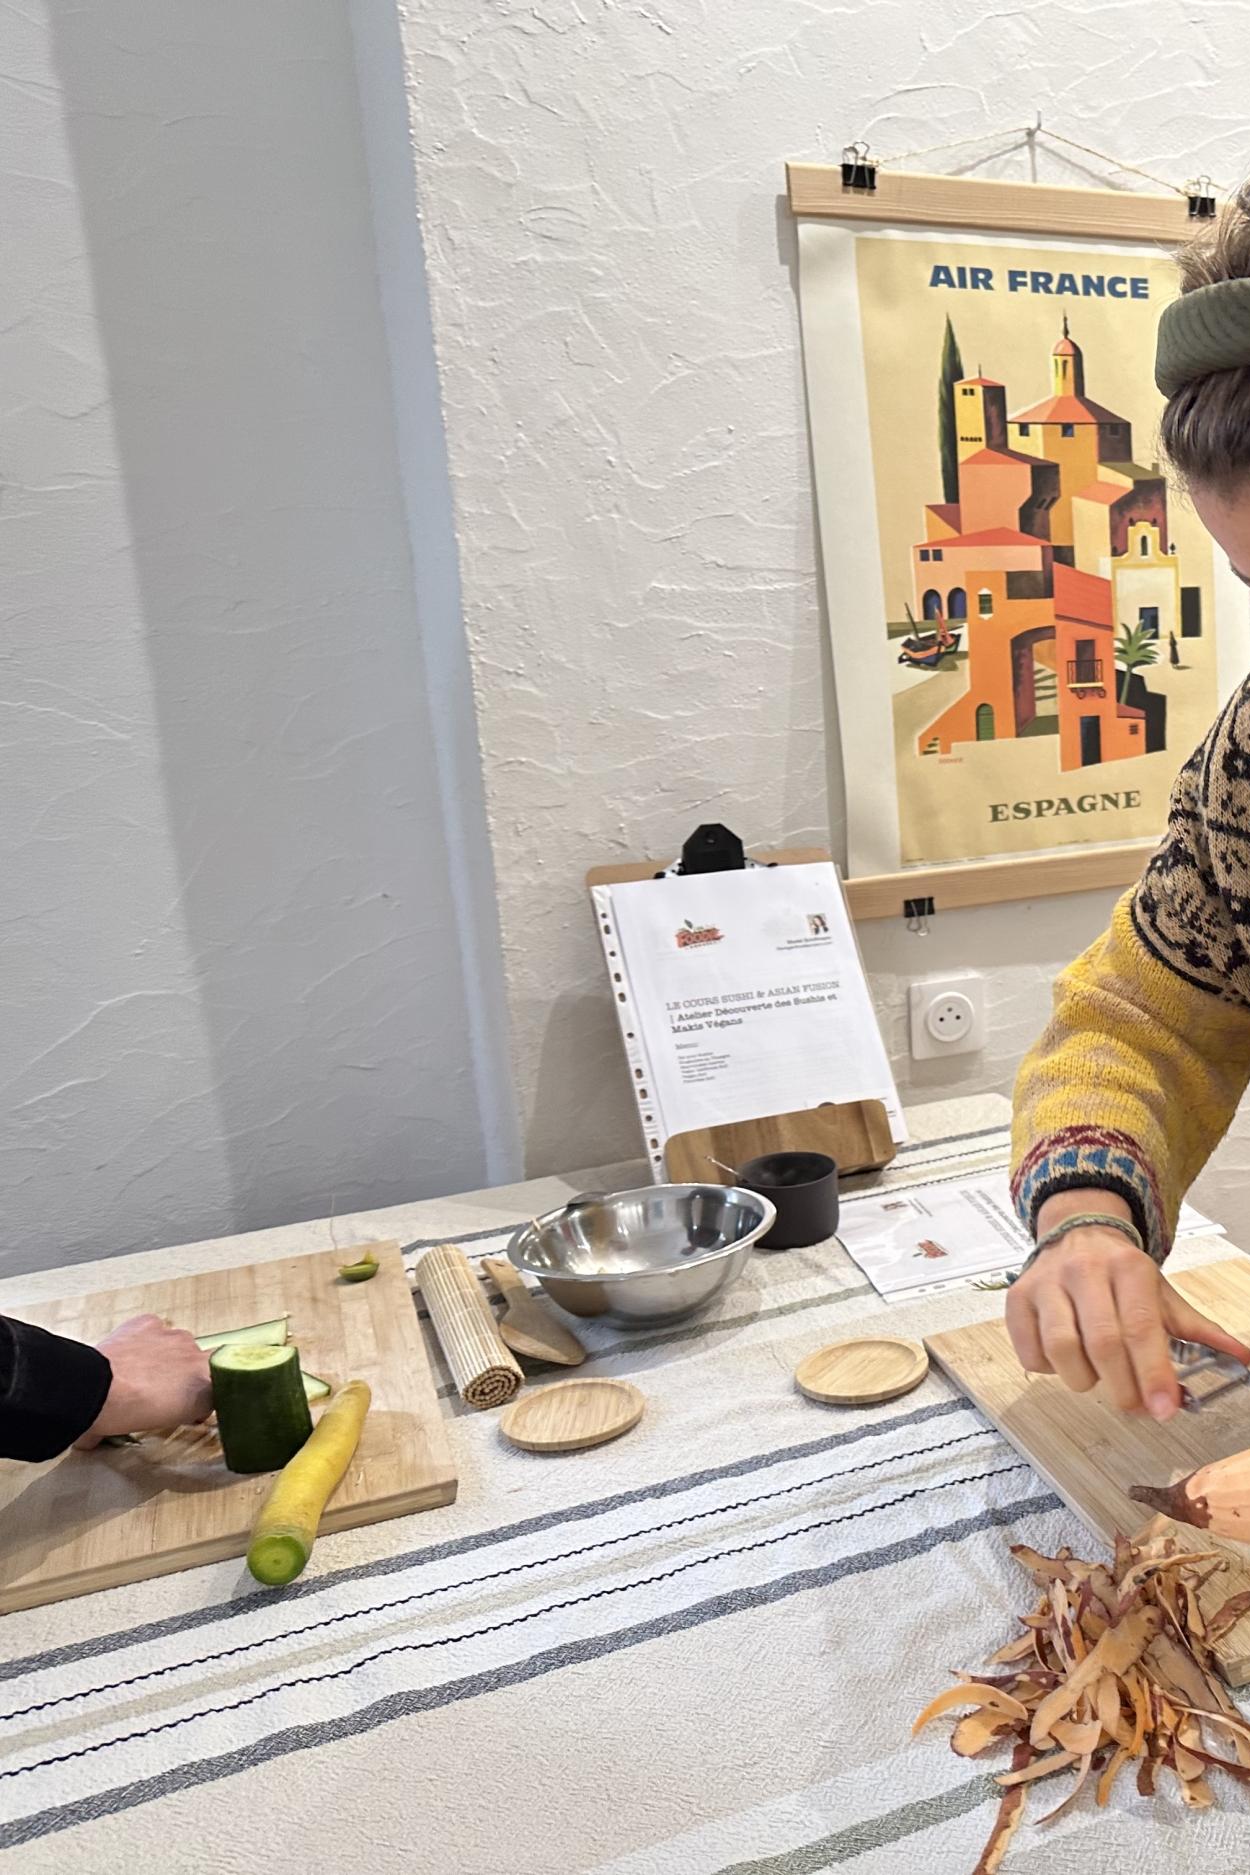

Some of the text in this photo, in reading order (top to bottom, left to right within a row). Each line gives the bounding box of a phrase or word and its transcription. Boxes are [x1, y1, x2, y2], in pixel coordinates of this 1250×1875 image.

[929, 265, 1149, 299] AIR FRANCE
[989, 790, 1141, 823] ESPAGNE
[666, 981, 840, 1011] LE COURS SUSHI & ASIAN FUSION
[677, 1010, 713, 1022] Atelier
[715, 1001, 772, 1016] Découverte
[775, 996, 792, 1008] des
[793, 993, 825, 1006] Sushis
[827, 993, 838, 1001] et
[672, 1017, 743, 1034] Makis Végans
